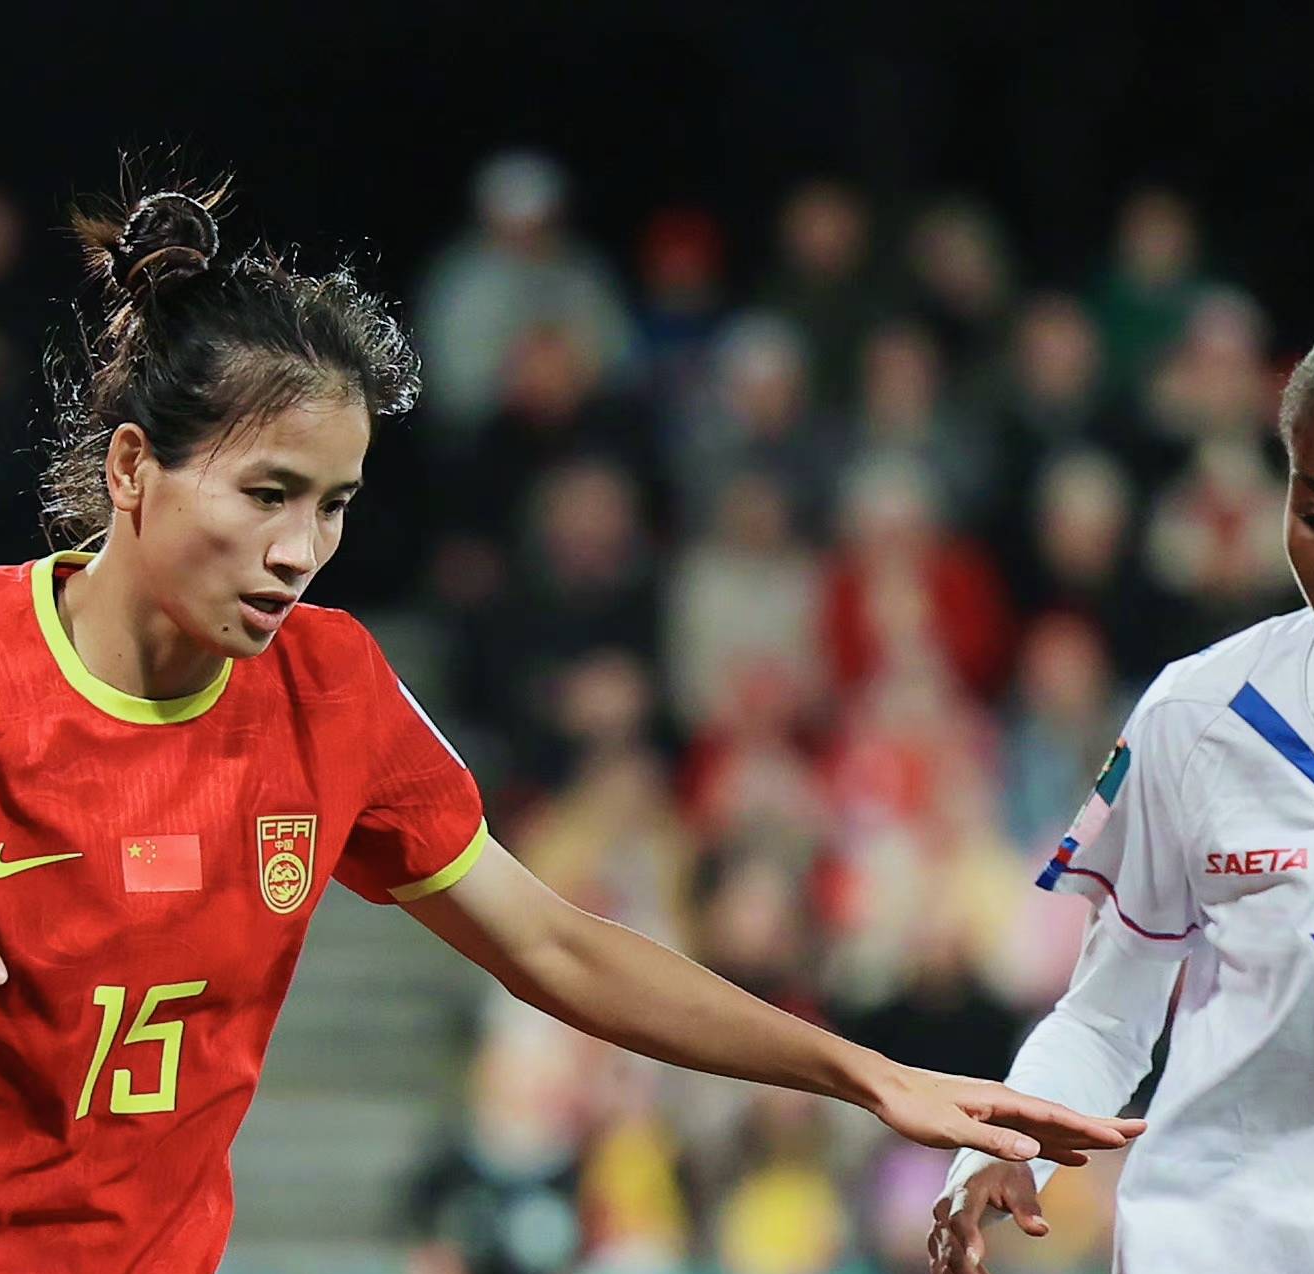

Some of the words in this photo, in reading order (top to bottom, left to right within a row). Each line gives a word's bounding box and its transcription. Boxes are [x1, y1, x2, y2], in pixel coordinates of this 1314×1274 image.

[262, 822, 310, 840] CFA
[1205, 848, 1307, 875] SAETA
[76, 980, 208, 1120] 15
